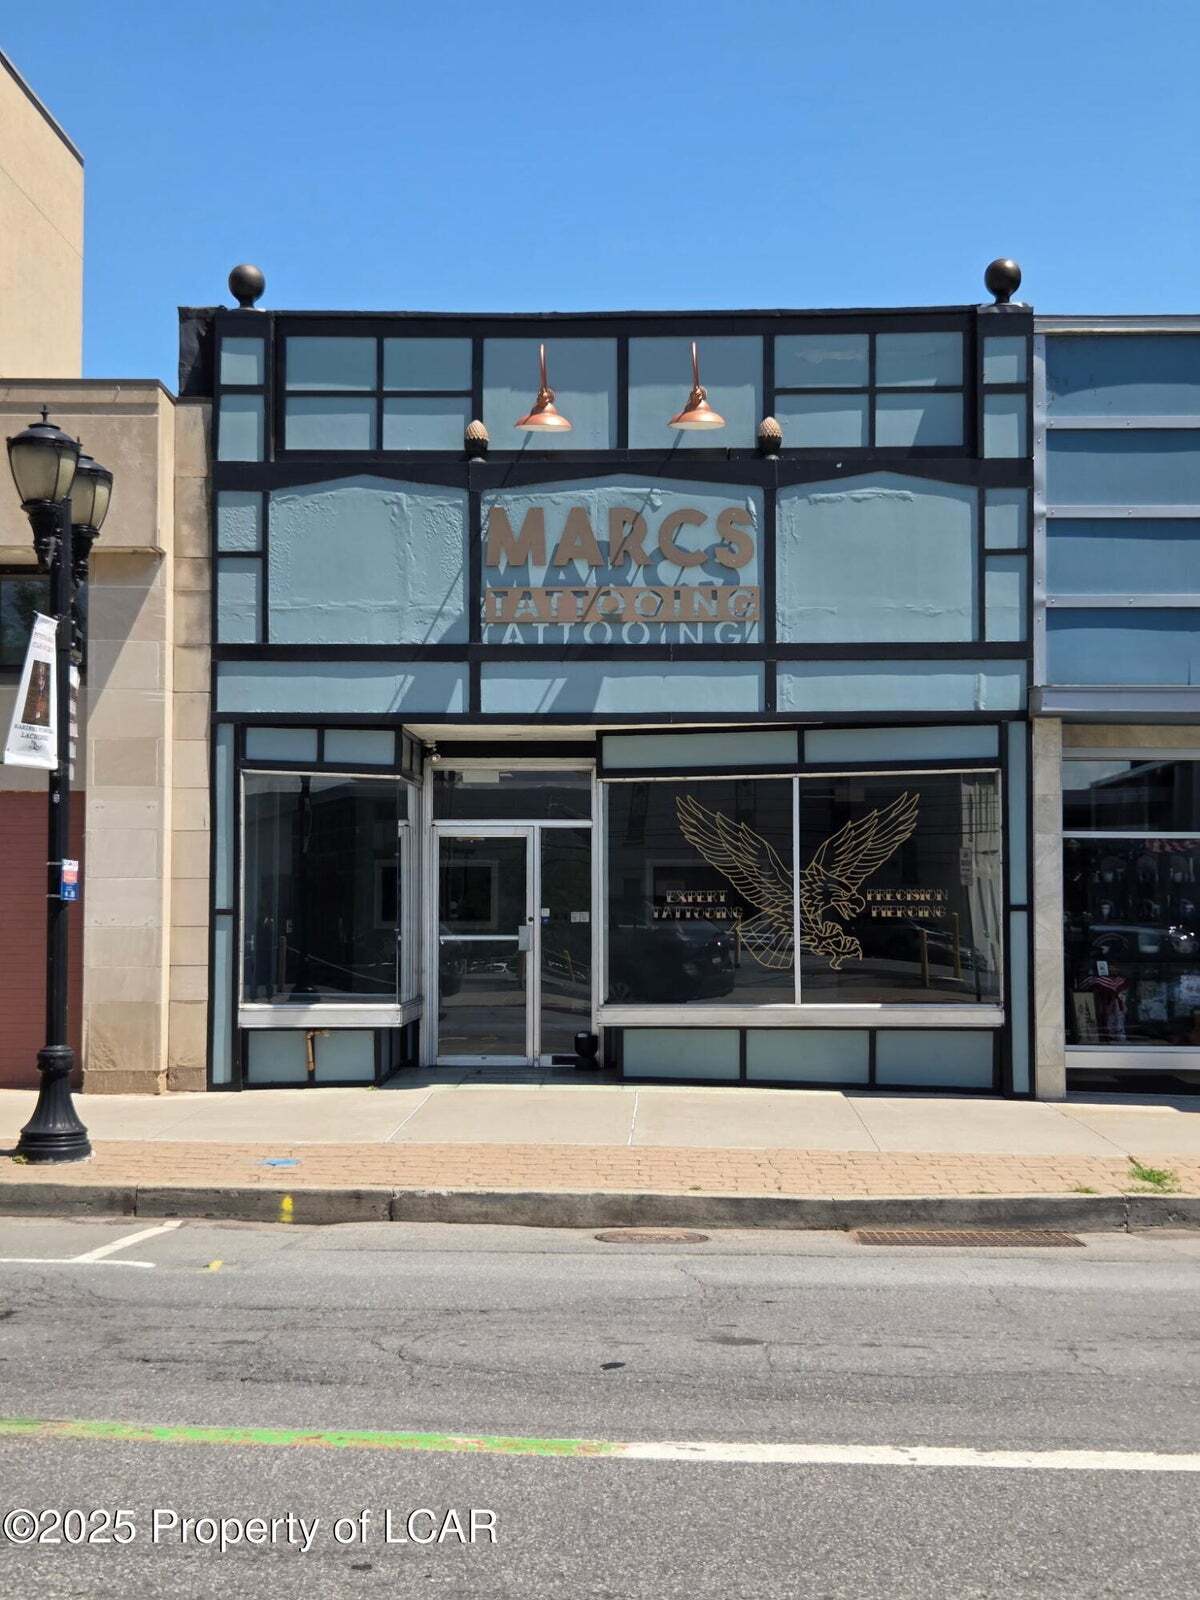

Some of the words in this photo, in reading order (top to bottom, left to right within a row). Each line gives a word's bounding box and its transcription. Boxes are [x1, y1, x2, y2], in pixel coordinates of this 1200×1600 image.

[485, 506, 756, 569] MARCS
[488, 588, 757, 619] TATTOOING
[665, 889, 728, 903] EXPERT
[866, 888, 949, 901] PRECISION
[652, 905, 744, 919] TATTOOING
[871, 905, 946, 918] PIERCING
